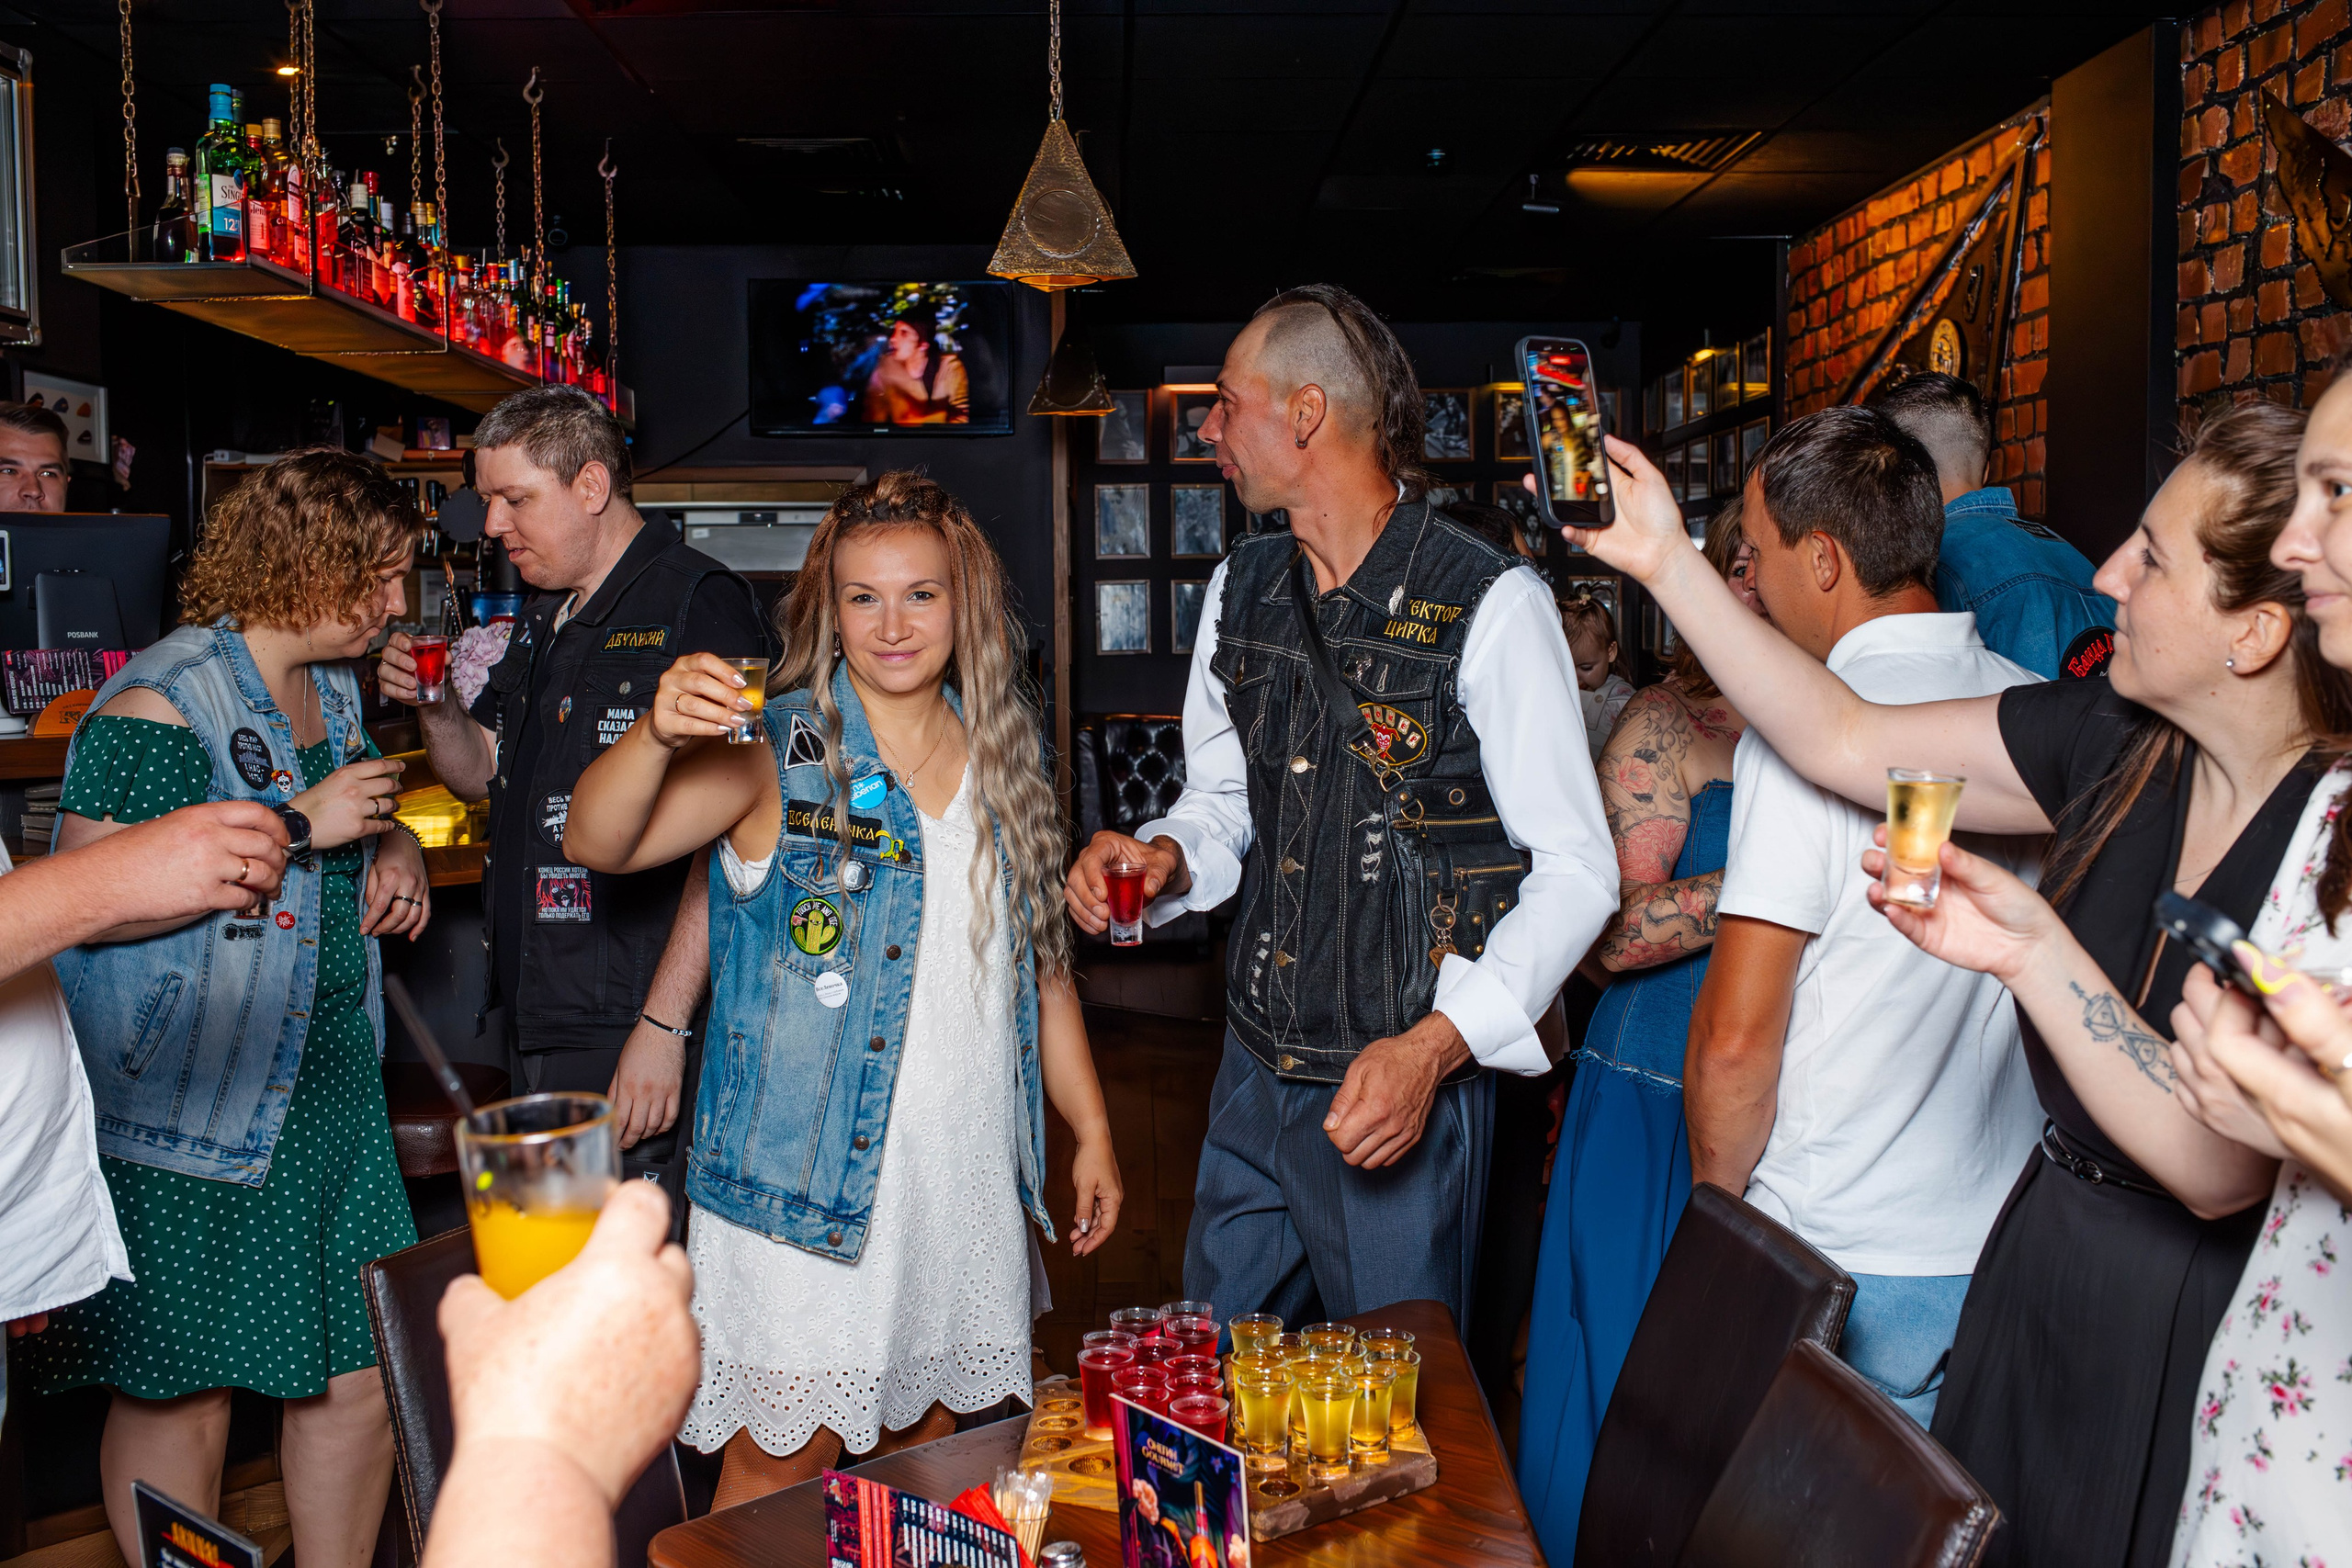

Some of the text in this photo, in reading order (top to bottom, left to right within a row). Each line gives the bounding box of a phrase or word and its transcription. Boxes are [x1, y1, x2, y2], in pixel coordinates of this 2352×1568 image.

[1408, 599, 1463, 623] ЕКТОР
[1383, 619, 1438, 644] ЦИРКА
[606, 708, 635, 720] МАМА
[548, 795, 564, 804] ВЕСЬ
[546, 803, 568, 813] ПРОТИВ
[788, 809, 875, 840] ВСЕЛЕНЧКА
[796, 902, 812, 917] TOUCH
[820, 905, 833, 917] AND
